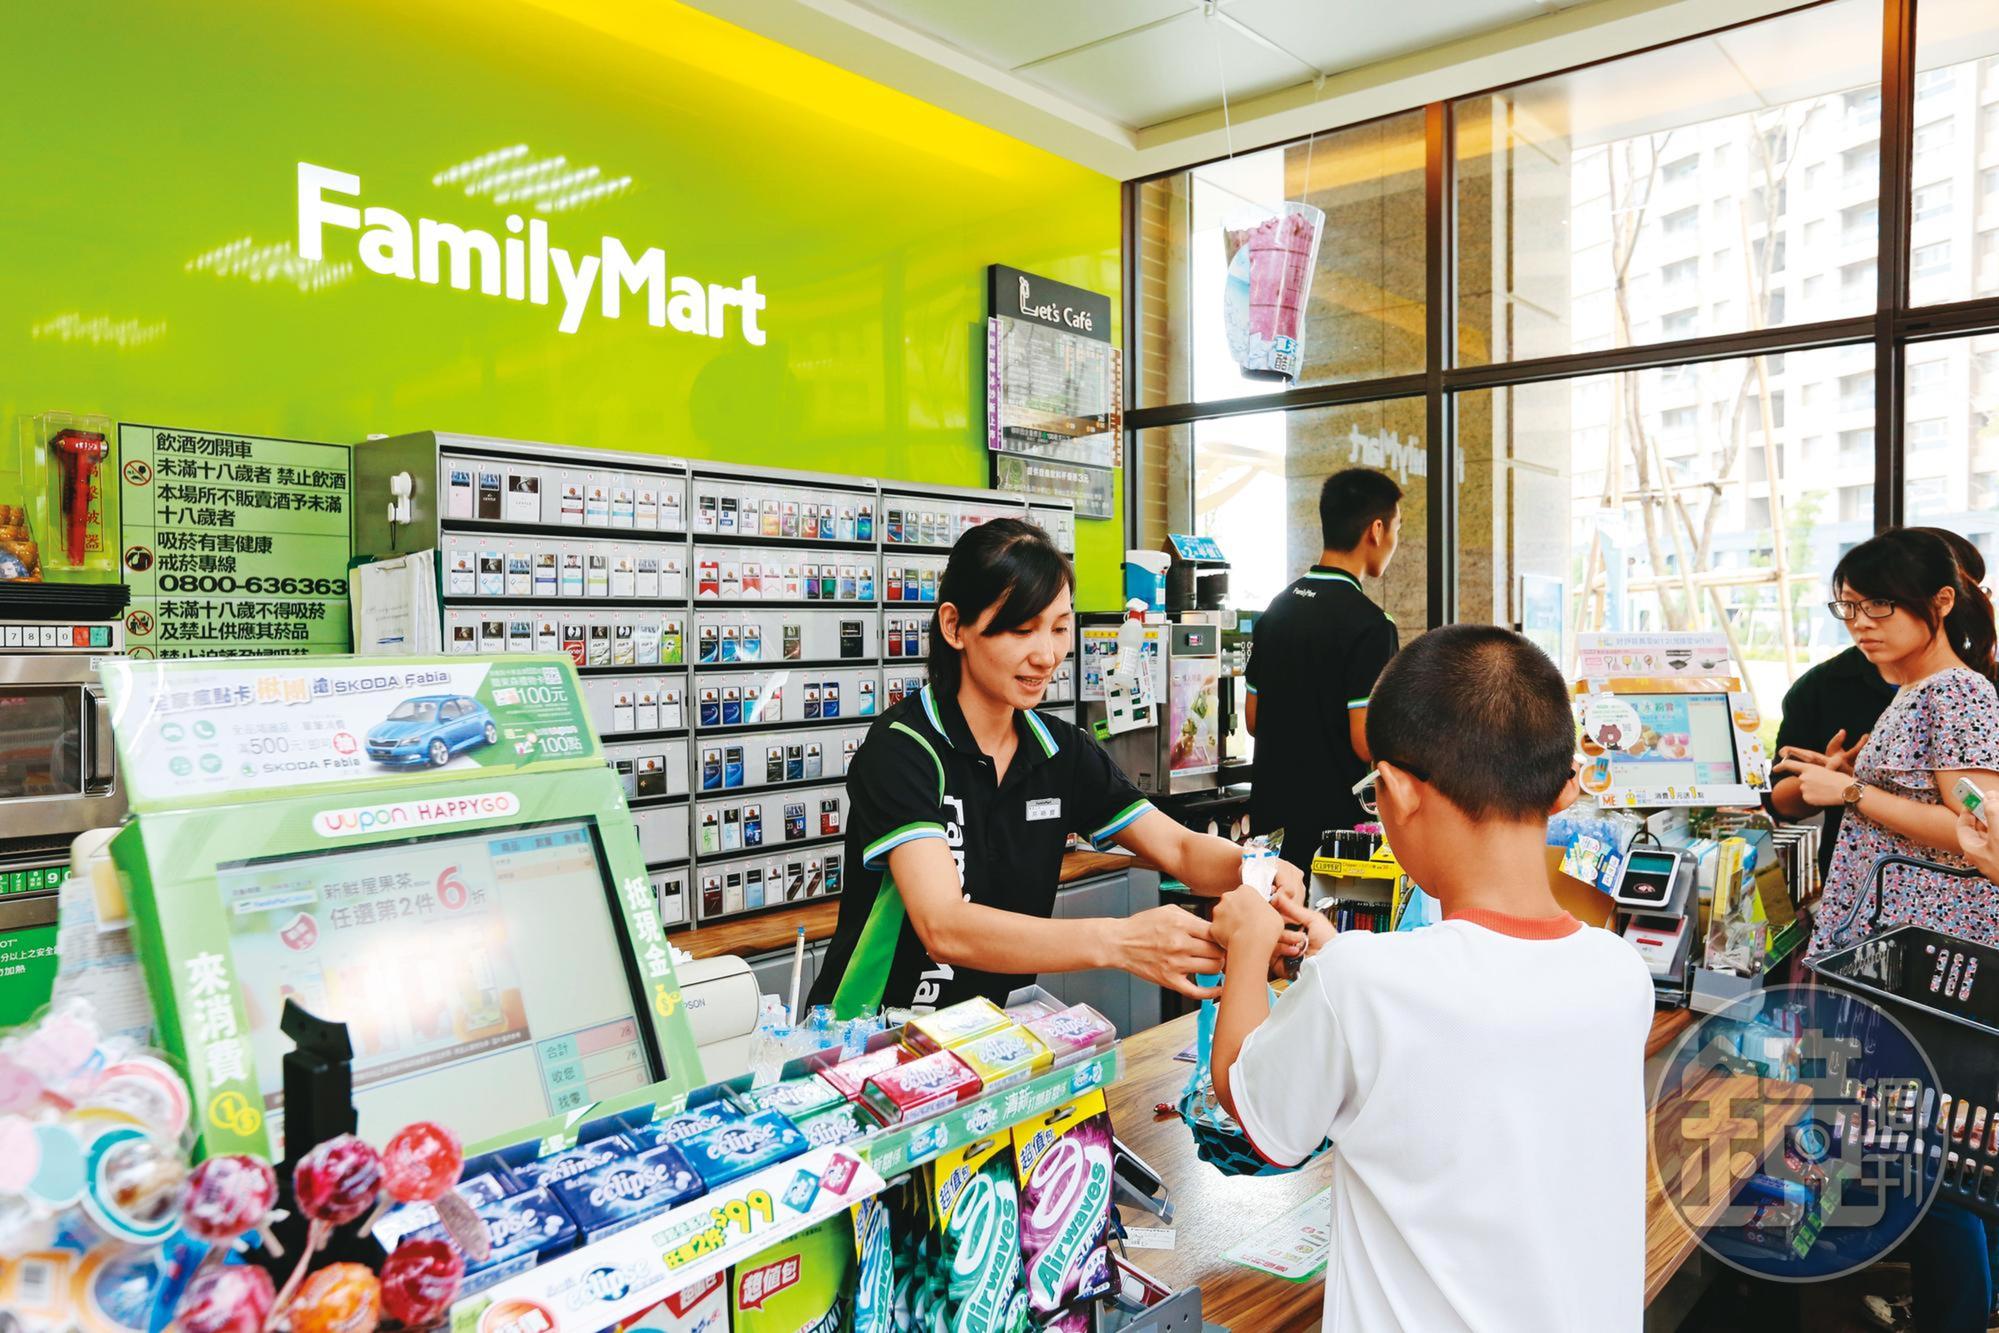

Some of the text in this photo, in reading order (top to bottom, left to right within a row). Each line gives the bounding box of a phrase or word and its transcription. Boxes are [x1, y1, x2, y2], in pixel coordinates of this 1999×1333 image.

[297, 161, 767, 346] FamilyMart
[1063, 306, 1093, 332] Café
[156, 433, 252, 459] 飲酒勿開車
[157, 459, 347, 489] 未滿十八歲者 禁止飲酒
[157, 482, 342, 513] 本場所不販賣酒予未滿
[157, 506, 235, 527] 十八歲者
[158, 532, 273, 554] 吸菸有害健康
[158, 554, 236, 573] 戒菸專線
[159, 575, 348, 595] 0800-636363
[159, 601, 326, 620] 未滿十八歲不得吸菸
[159, 621, 309, 641] 及禁止供應其菸品
[335, 676, 400, 694] SKODA
[406, 669, 450, 686] Fabia
[518, 686, 568, 705] 100元
[539, 736, 583, 754] 100點
[262, 757, 361, 773] SKODA Fabia
[418, 795, 510, 818] HAPPYGO
[47, 872, 58, 884] 9
[324, 873, 413, 900] 新鮮屋果茶
[330, 893, 435, 931] 任選第2件
[622, 876, 672, 979] 抵現金
[185, 951, 248, 1087] 來消費
[1047, 1012, 1090, 1041] eclipse
[548, 1041, 570, 1059] 合計
[978, 1036, 1025, 1064] eclipse
[901, 1062, 953, 1092] eclipse
[558, 1091, 582, 1109] 找零
[706, 1121, 776, 1160] eclipse
[1020, 1128, 1055, 1173] 超值包
[590, 1163, 669, 1208] eclipse
[939, 1165, 971, 1215] 超值包
[710, 1188, 774, 1234] $99
[1037, 1161, 1106, 1302] Airwaves
[1076, 1210, 1108, 1269] SUPER
[966, 1198, 1016, 1333] Airwaves
[742, 1258, 798, 1305] 超值包
